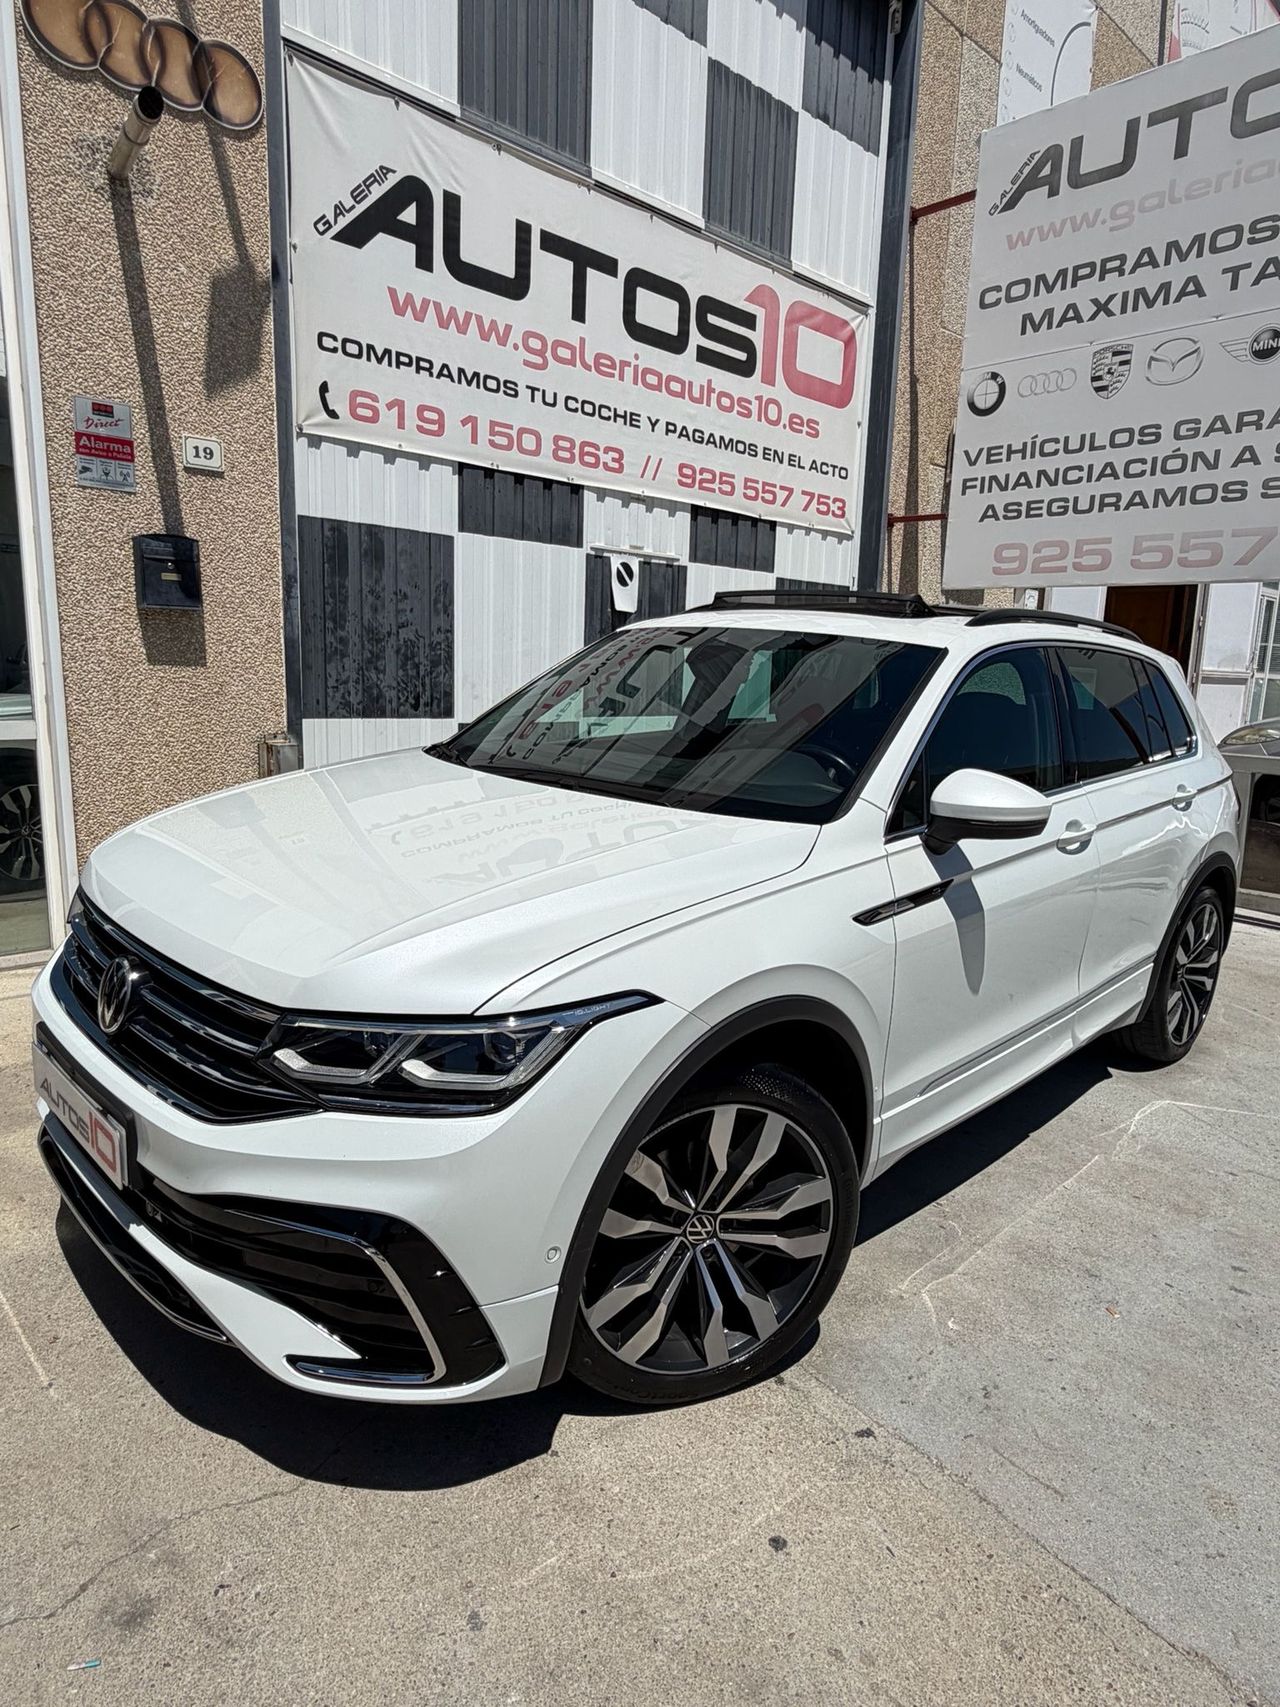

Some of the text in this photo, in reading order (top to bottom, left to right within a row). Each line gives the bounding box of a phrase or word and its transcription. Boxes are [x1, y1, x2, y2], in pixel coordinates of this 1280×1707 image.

[313, 164, 398, 237] GALERIA
[988, 150, 1041, 217] GALERIA
[1005, 158, 1280, 252] www.galeria
[978, 214, 1280, 311] COMPRAMOS
[1019, 256, 1280, 337] MAXIMA TA
[386, 285, 820, 439] www.galeriaautos10.es
[83, 415, 124, 429] Direct
[316, 331, 849, 481] COMPRAMOS TU COCHE Y PAGAMOS EN EL ACTO
[79, 435, 132, 454] Alarma
[192, 445, 214, 460] 19
[348, 389, 446, 438] 619
[459, 414, 542, 457] 150
[552, 433, 625, 474] 863
[676, 462, 736, 497] 925
[742, 476, 794, 508] 557
[800, 489, 847, 519] 753
[961, 446, 1221, 497] FINANCIACIÓN
[1229, 444, 1262, 469] A
[963, 423, 1162, 468] VEHÍCULOS
[978, 479, 1249, 523] ASEGURAMOS
[991, 525, 1279, 576] 925 557
